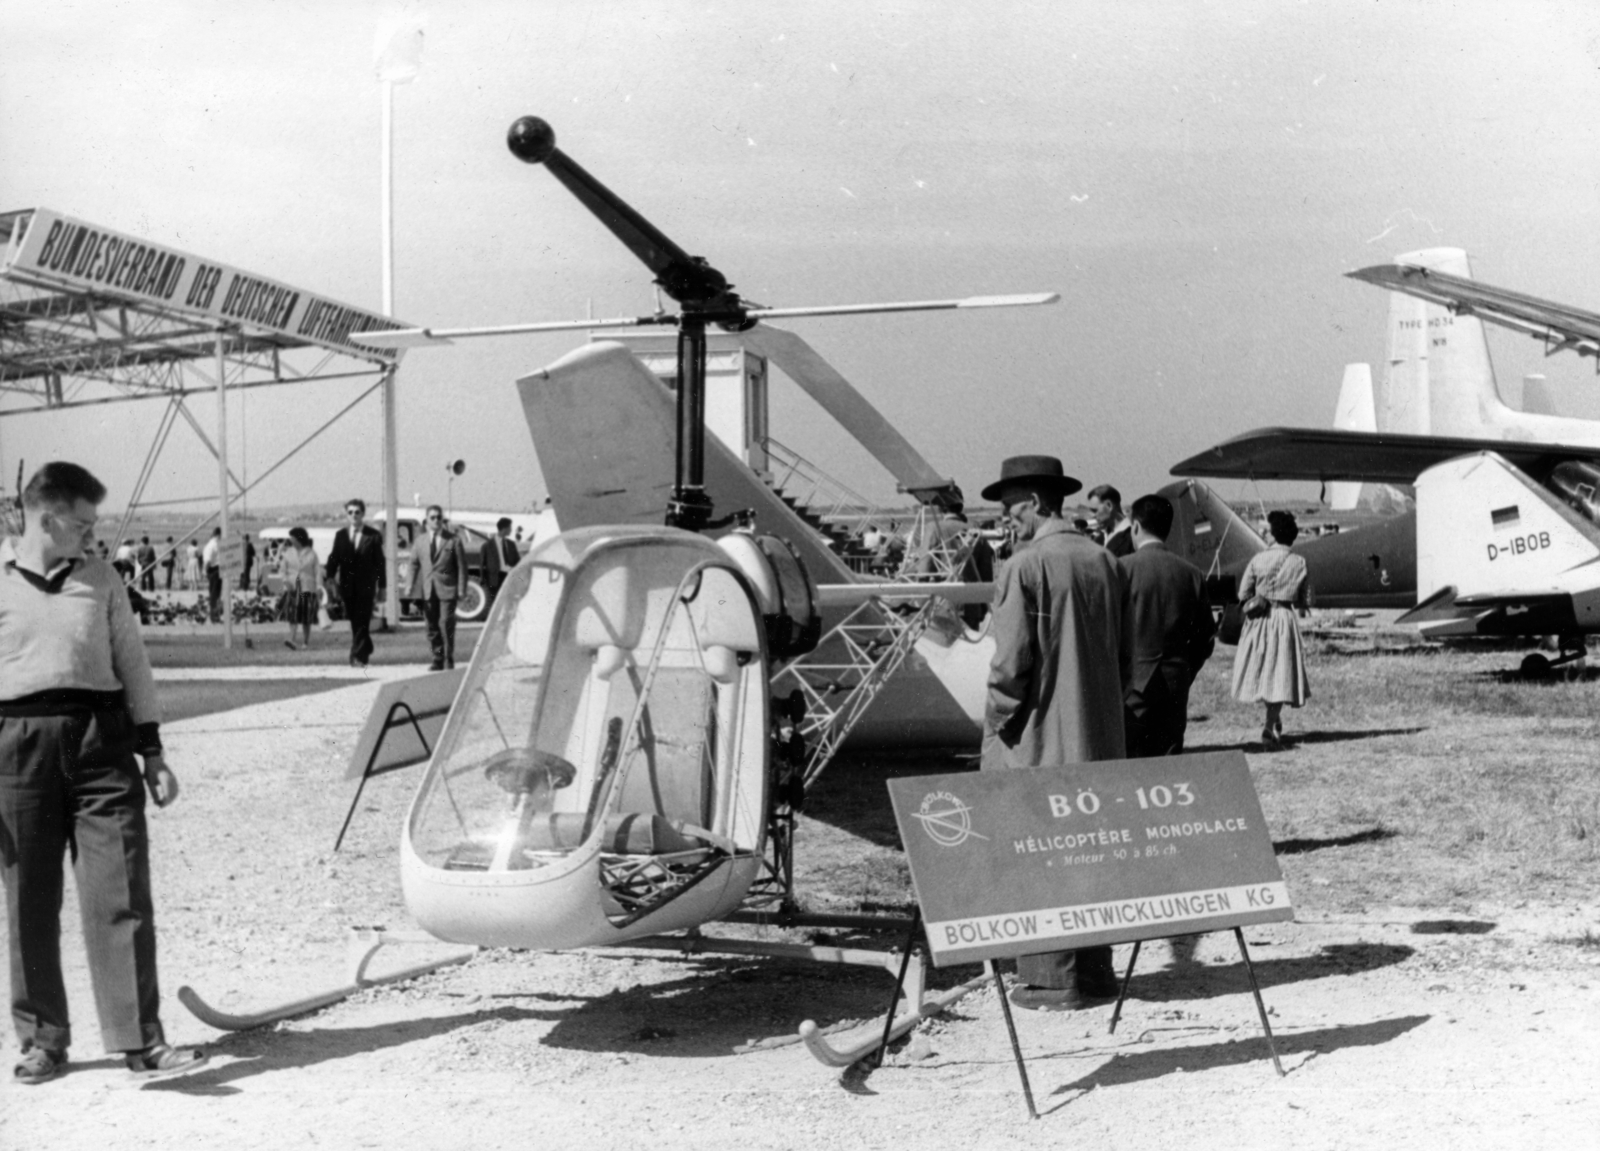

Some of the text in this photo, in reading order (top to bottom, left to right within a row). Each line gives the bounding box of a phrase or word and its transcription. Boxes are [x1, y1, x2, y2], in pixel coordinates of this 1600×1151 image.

[37, 219, 186, 300] BUNDESVERBAND
[185, 263, 222, 310] DER
[1487, 531, 1551, 561] D-IBOB
[1048, 787, 1100, 818] BÖ
[1135, 782, 1195, 810] 103
[1013, 817, 1248, 854] HÉLICOPTÈRE MONOPLACE
[1063, 853, 1105, 866] Moteur
[1145, 844, 1159, 857] 85
[945, 915, 1037, 945] BÖLKOW
[1059, 891, 1232, 931] ENTWICKLUNGEN
[1245, 886, 1275, 907] KG
